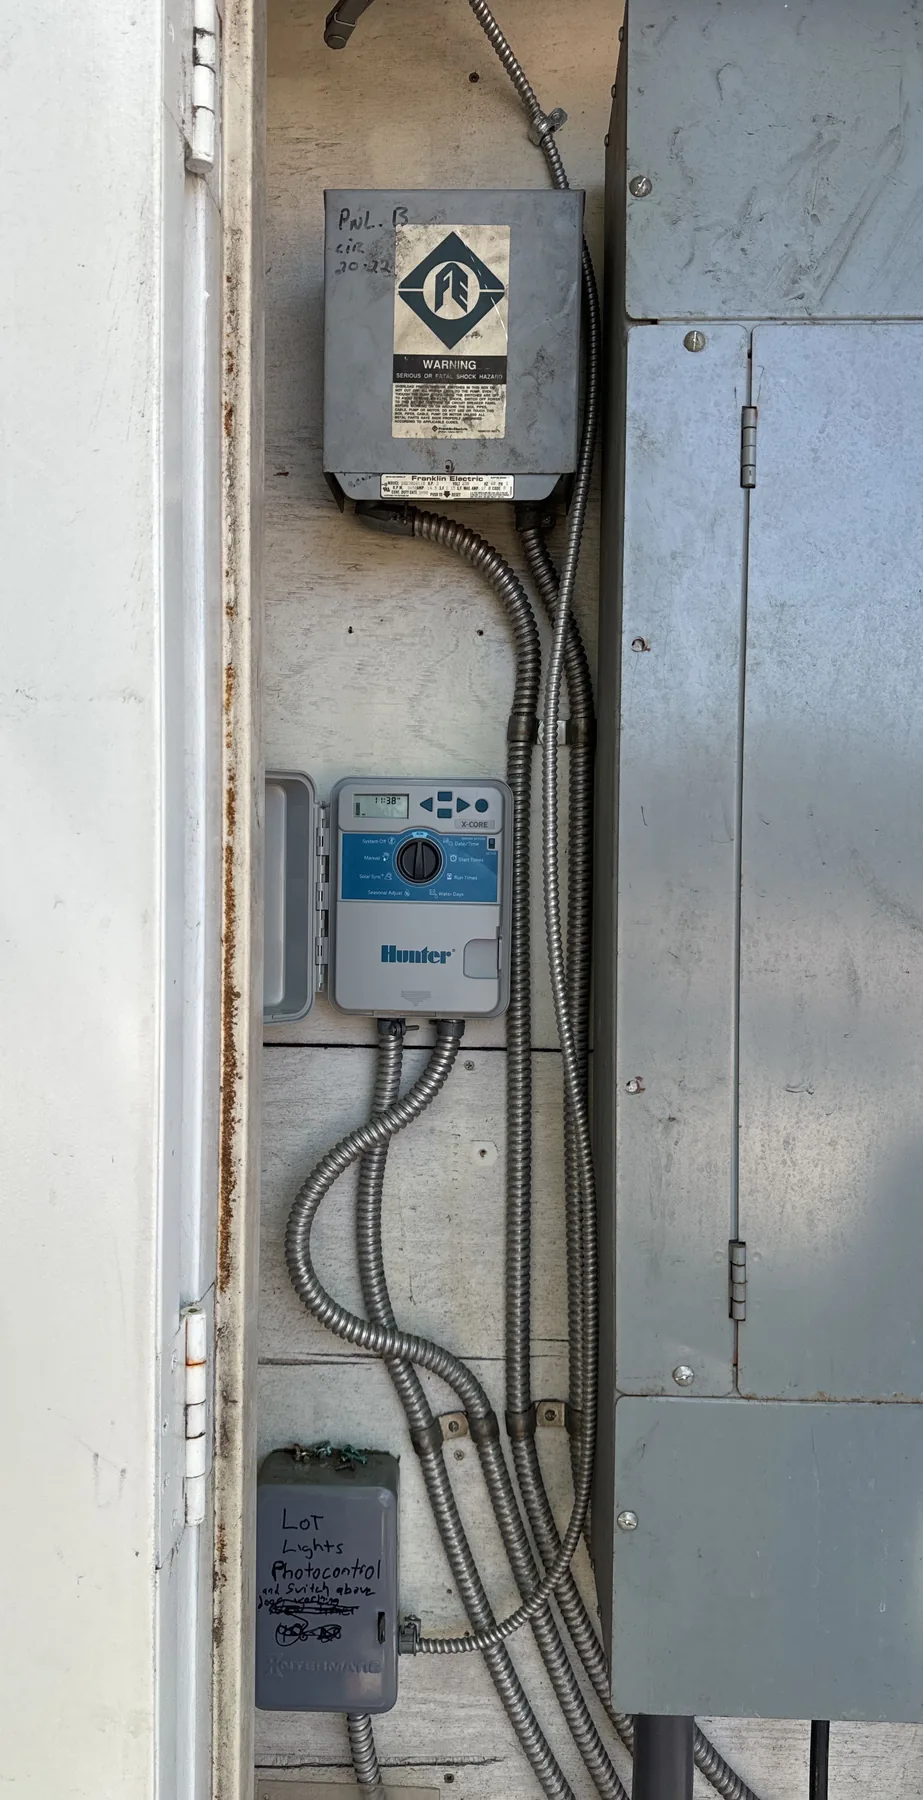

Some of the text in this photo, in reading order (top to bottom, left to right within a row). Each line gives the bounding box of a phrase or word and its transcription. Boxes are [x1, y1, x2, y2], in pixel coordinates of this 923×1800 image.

[423, 360, 476, 370] WARNING
[381, 945, 451, 964] Hunter
[282, 1538, 344, 1559] Lights
[272, 1558, 381, 1581] Photocontrol
[262, 1584, 280, 1595] and
[336, 1583, 376, 1596] above
